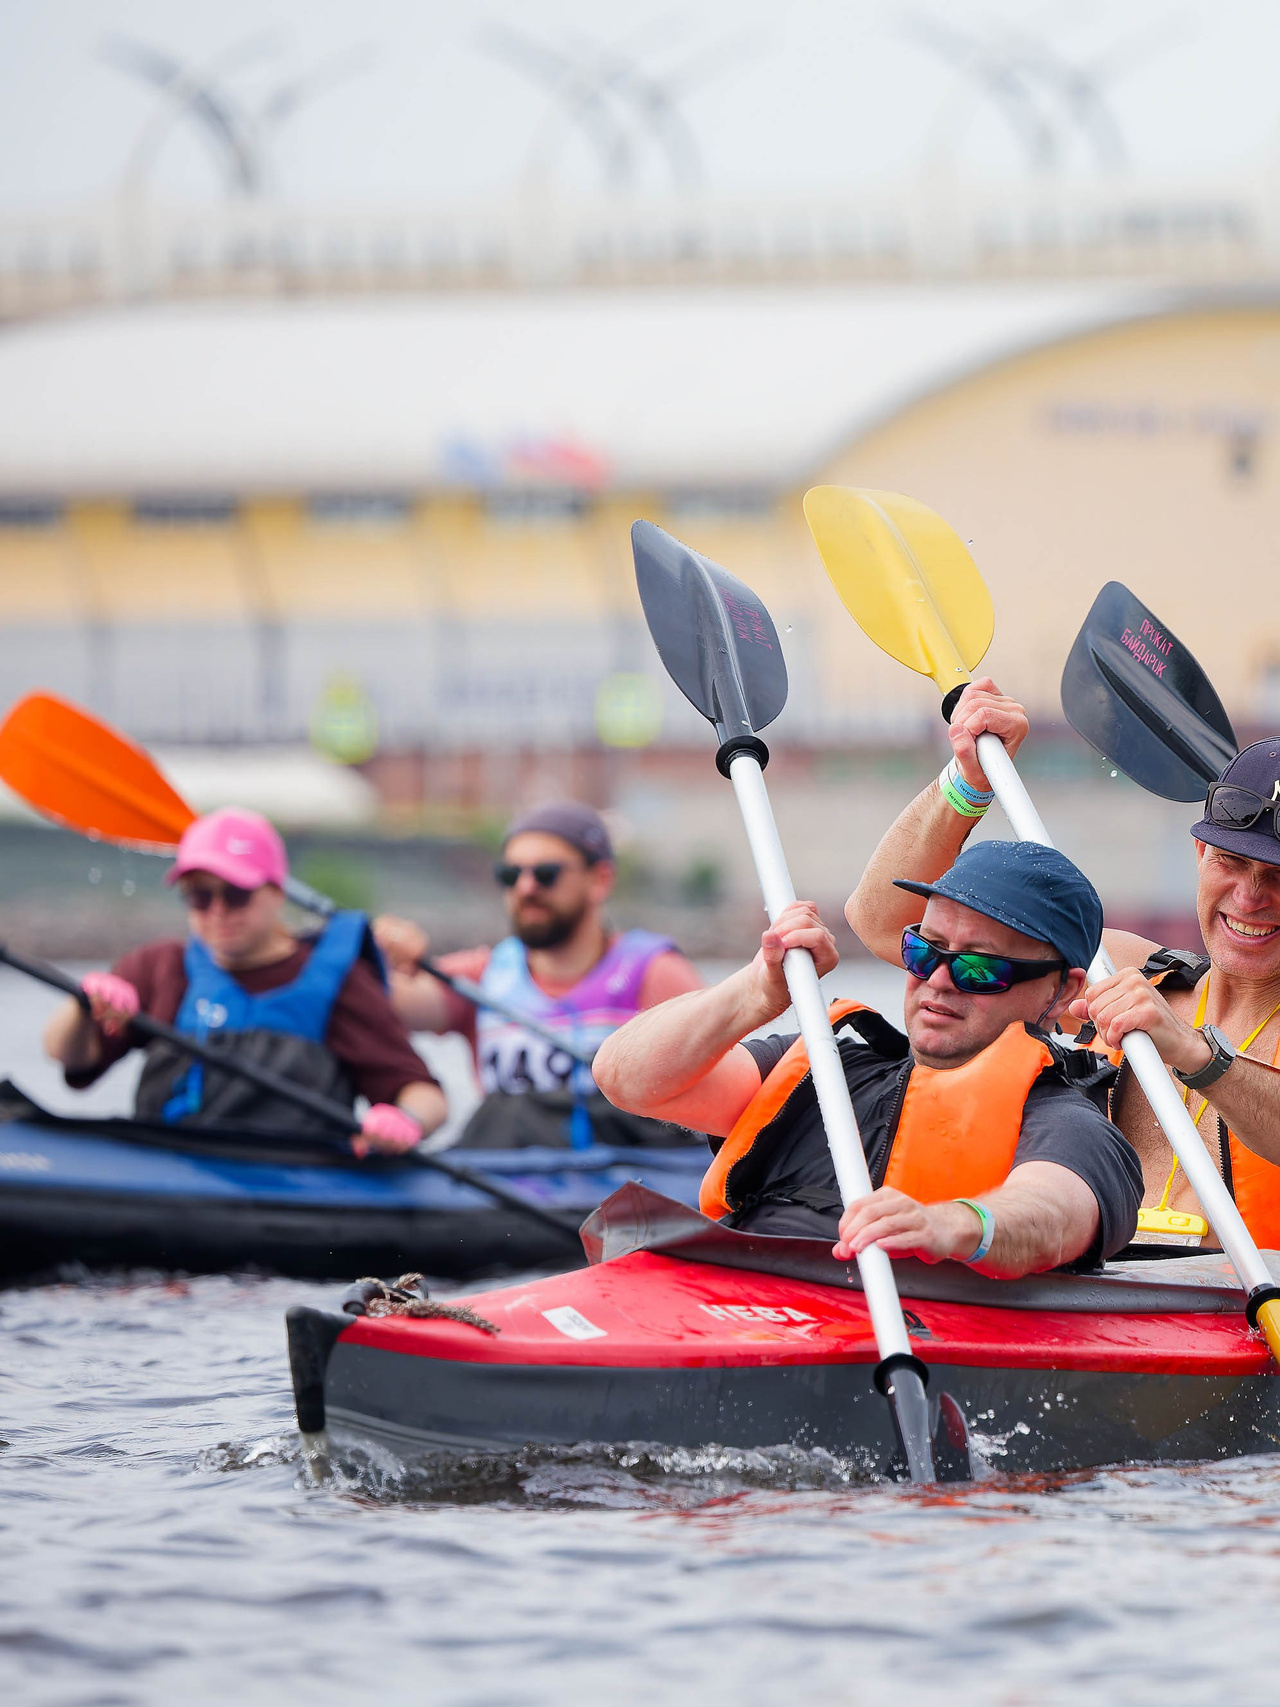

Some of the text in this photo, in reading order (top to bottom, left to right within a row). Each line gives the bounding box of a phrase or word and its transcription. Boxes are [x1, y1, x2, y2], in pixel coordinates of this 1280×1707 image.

[1120, 627, 1167, 679] БАЙДАРОК
[1140, 618, 1174, 657] ПРОКАТ
[698, 1304, 818, 1322] НЕВА
